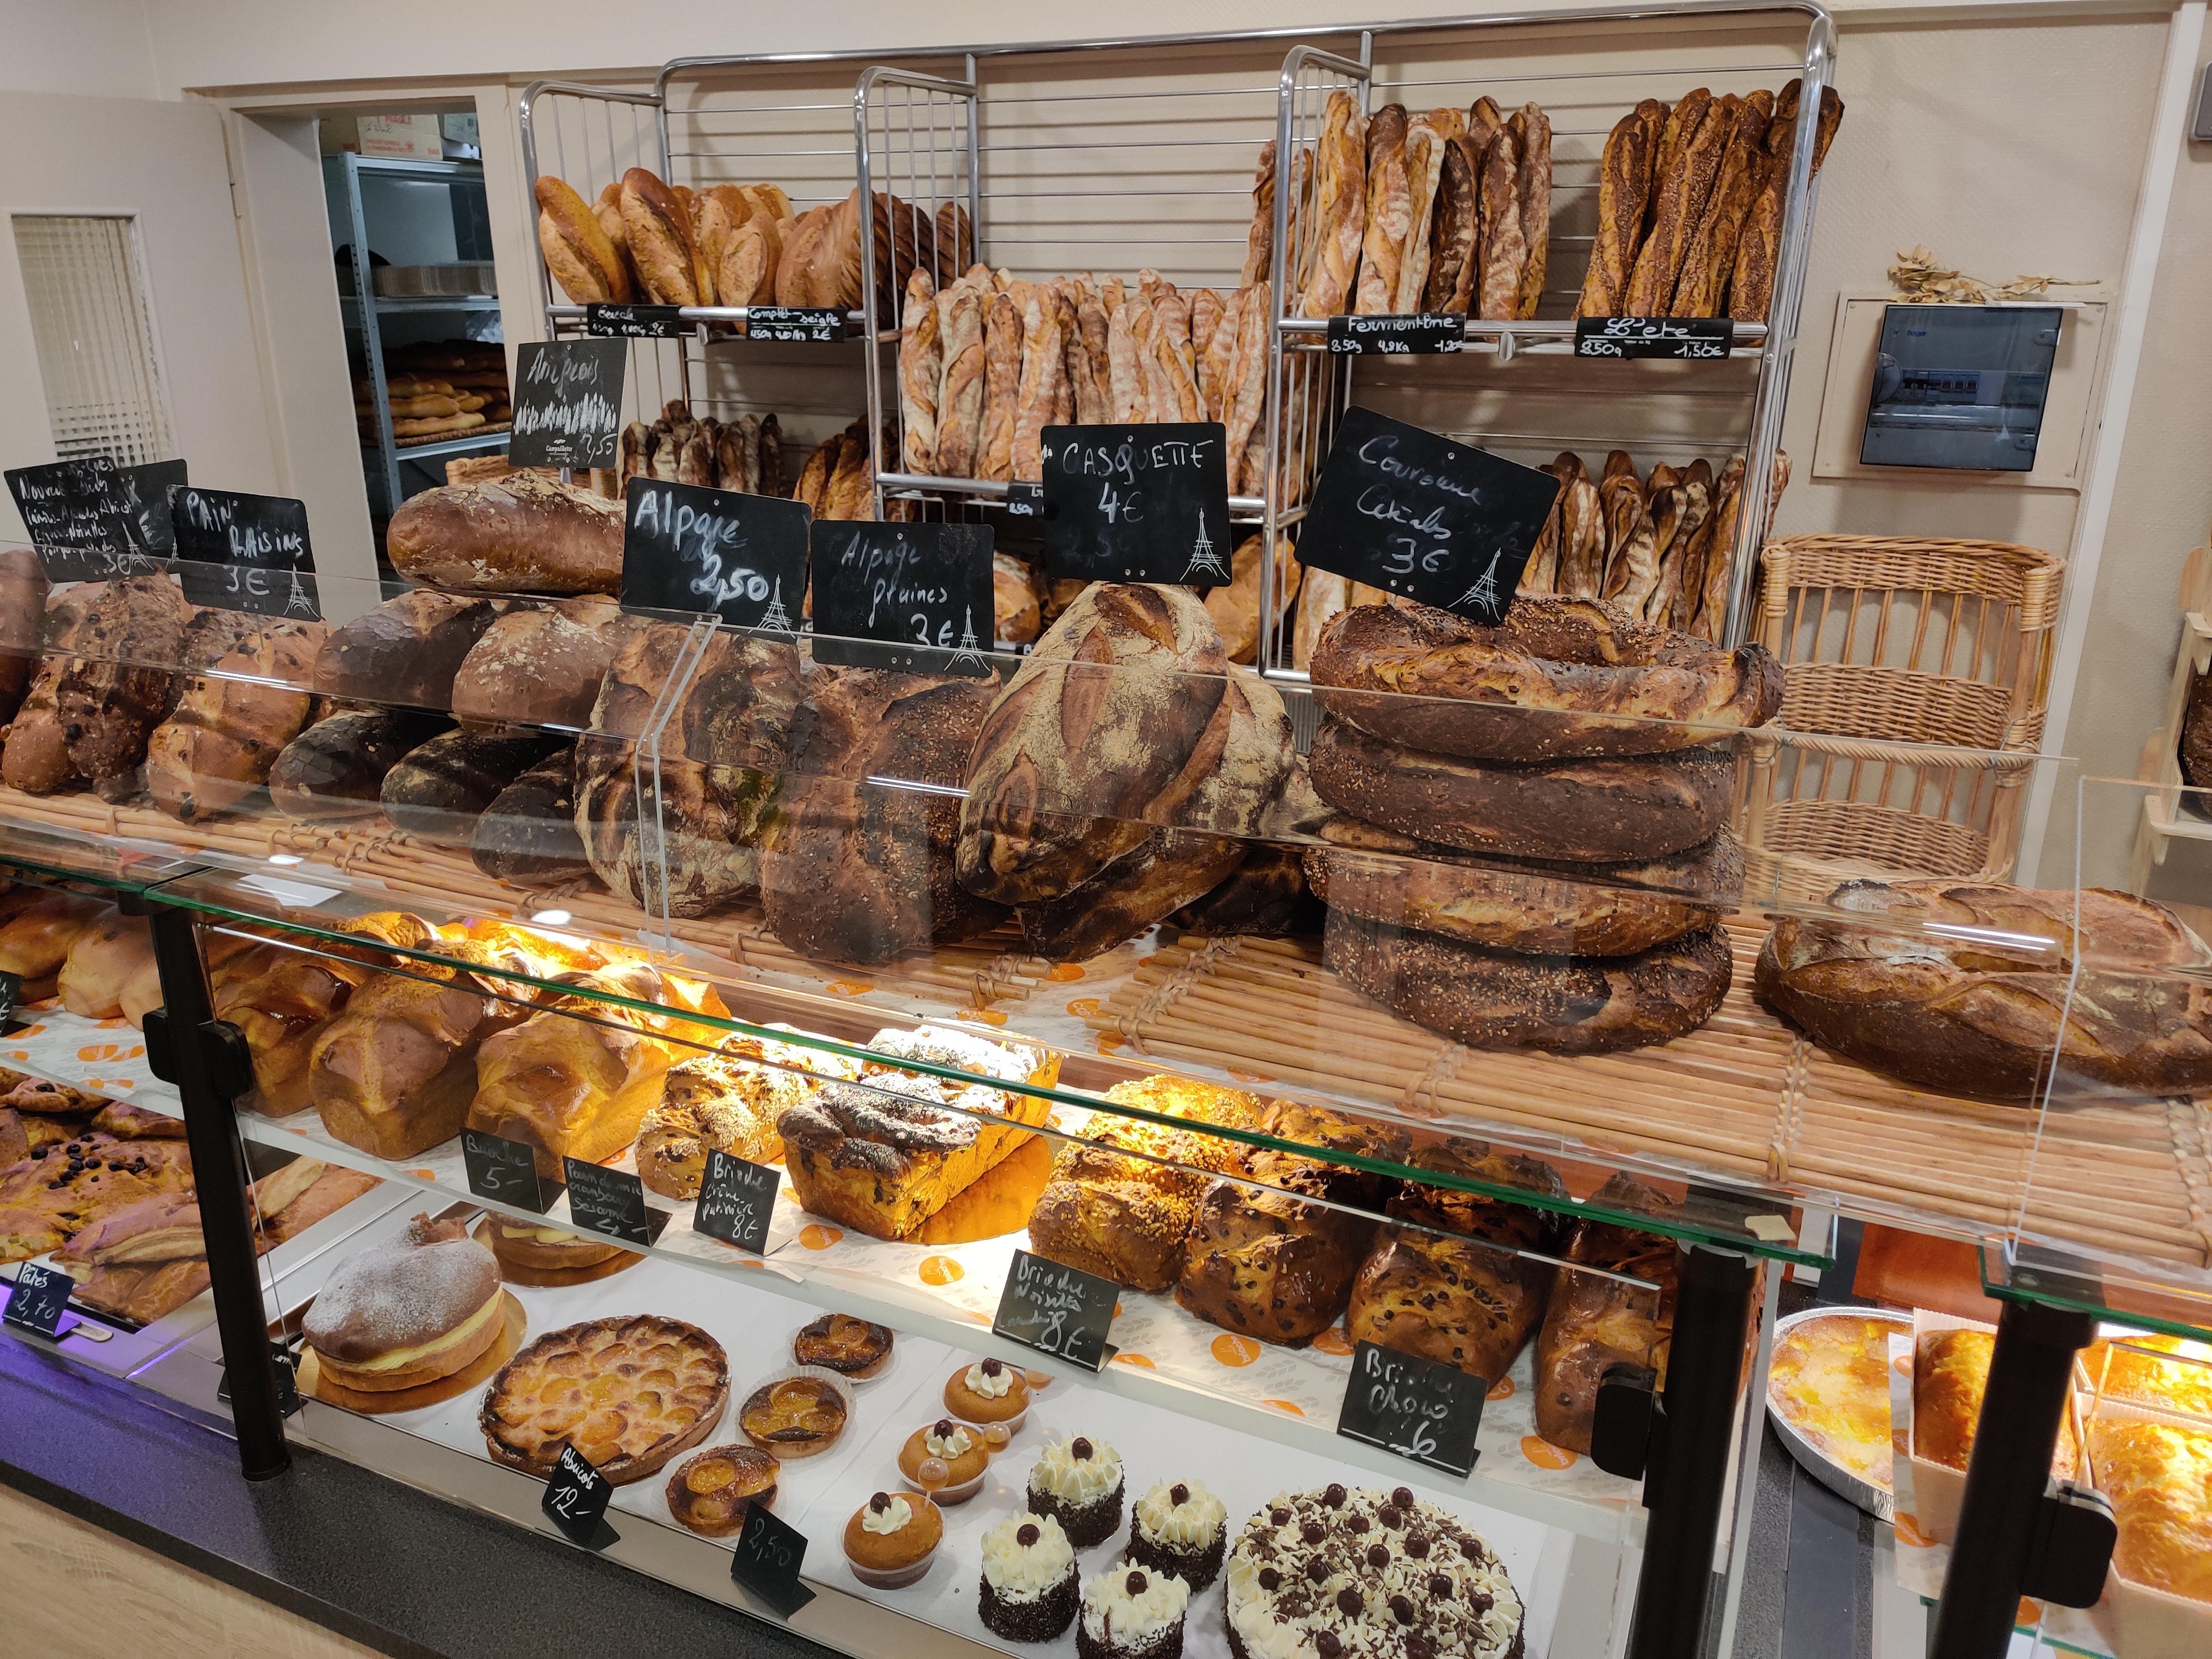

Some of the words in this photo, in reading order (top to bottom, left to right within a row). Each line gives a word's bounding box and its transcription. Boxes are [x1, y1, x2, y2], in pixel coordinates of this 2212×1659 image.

[1063, 440, 1214, 485] CASQUETTE
[1098, 482, 1144, 524] 4€
[226, 565, 270, 596] 3€
[1551, 1444, 1571, 1466] brio
